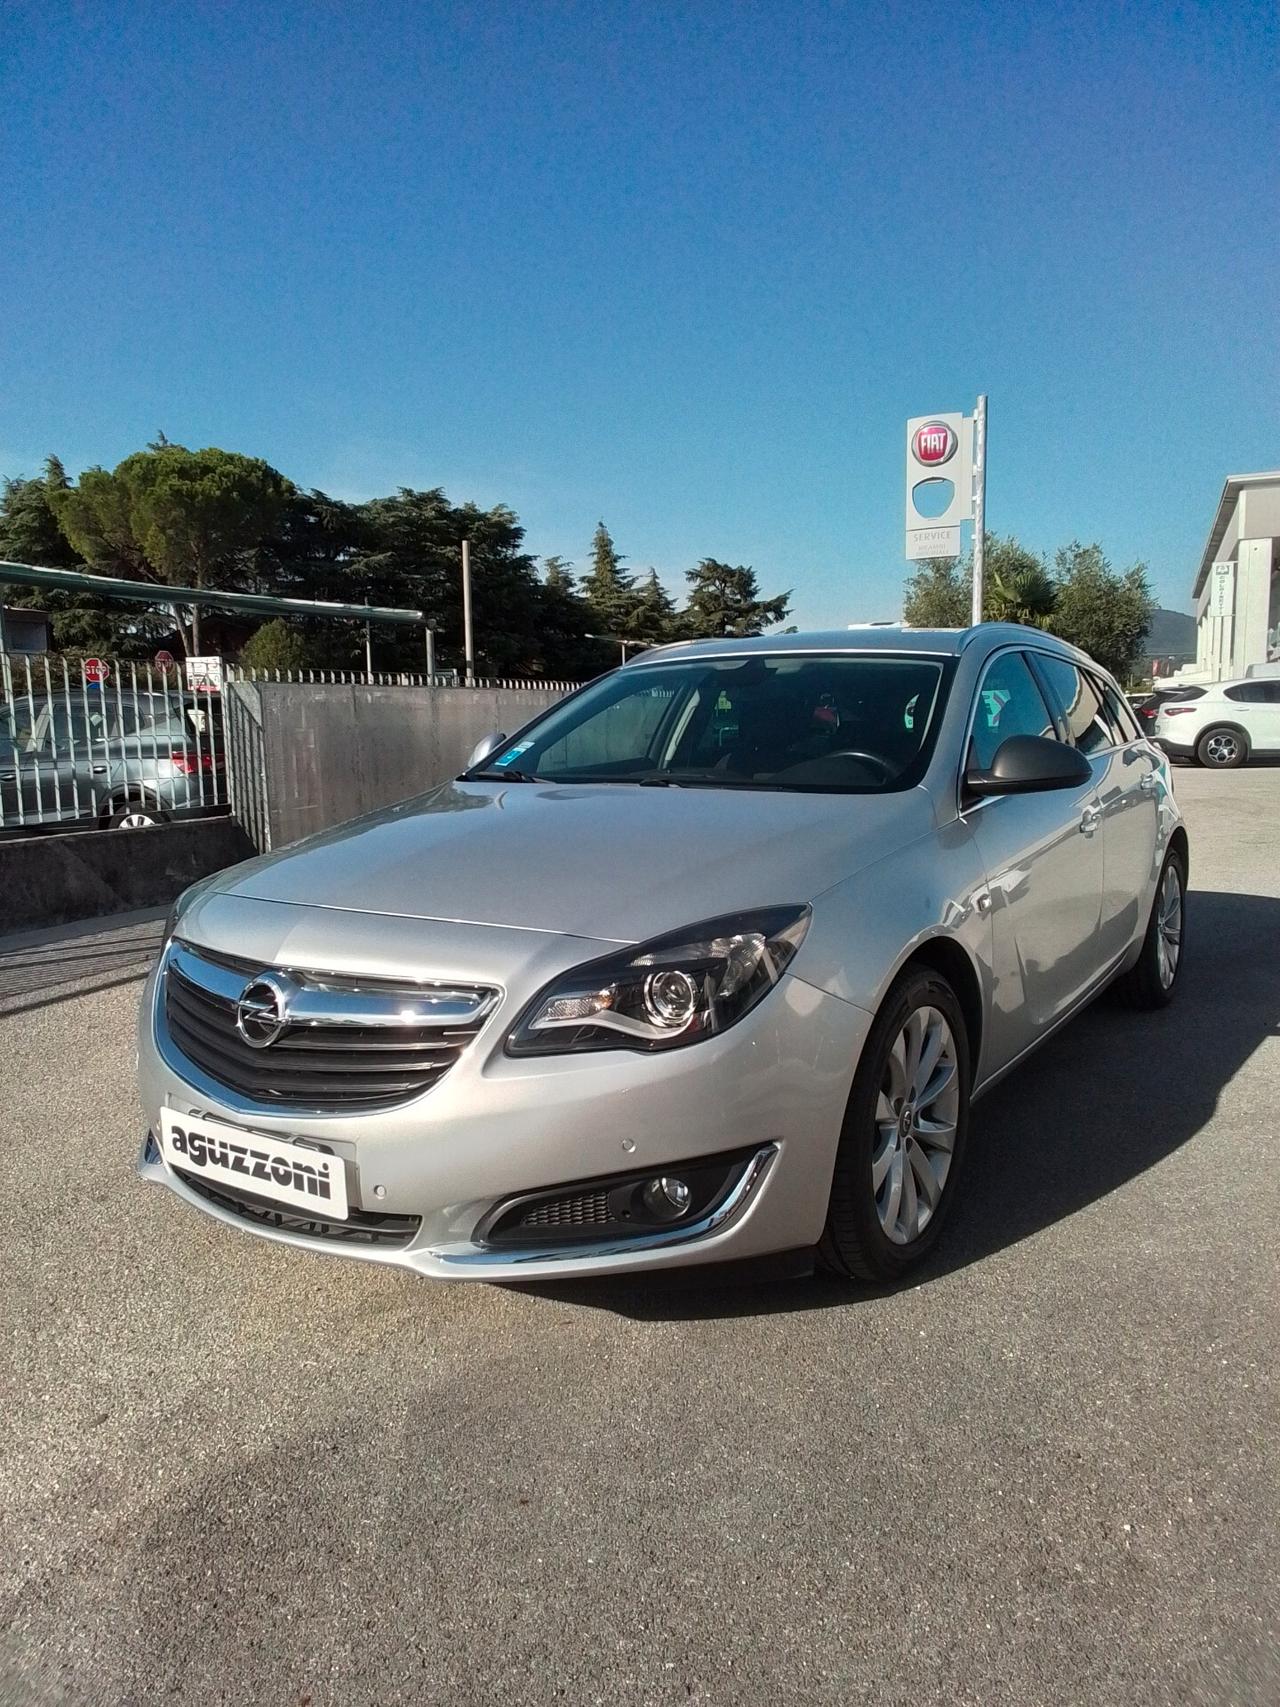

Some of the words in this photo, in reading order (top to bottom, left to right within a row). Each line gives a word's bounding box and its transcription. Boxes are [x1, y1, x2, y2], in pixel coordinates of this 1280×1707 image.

[921, 432, 946, 454] FIAT
[913, 531, 952, 542] SERVICE
[86, 665, 107, 675] STOP
[171, 1125, 331, 1200] aguzzoni
